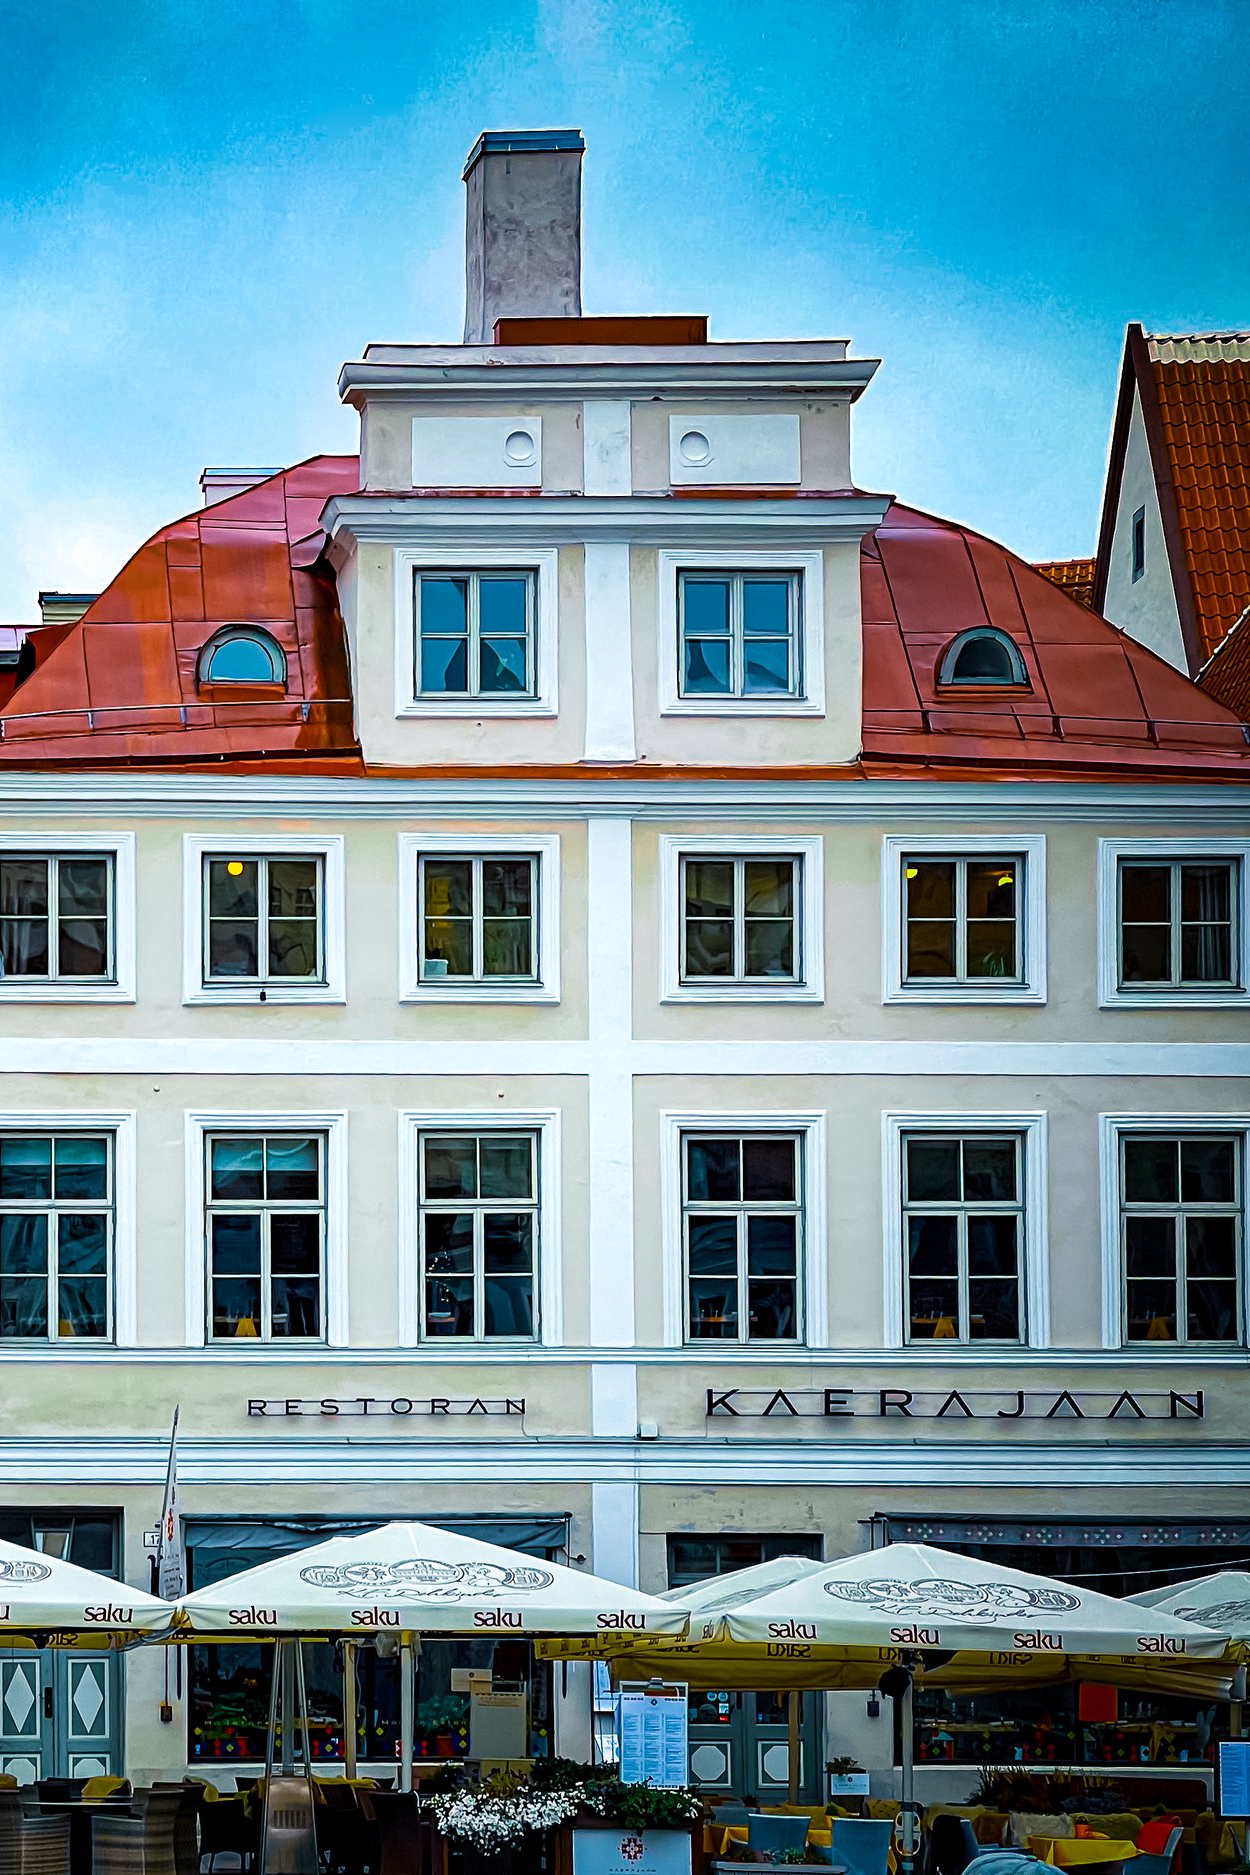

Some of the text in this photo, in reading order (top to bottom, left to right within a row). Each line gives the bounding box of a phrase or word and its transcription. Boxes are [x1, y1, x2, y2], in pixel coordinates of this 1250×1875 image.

[248, 1398, 526, 1416] RESTORAN
[706, 1388, 1204, 1419] KAERAJAAN
[83, 1603, 133, 1623] saku
[228, 1605, 277, 1625] saku
[350, 1606, 400, 1626] saku
[473, 1607, 523, 1627] saku
[597, 1609, 646, 1629] saku
[768, 1619, 817, 1639] saku
[890, 1624, 940, 1644] saku
[1013, 1630, 1063, 1649] saku
[1136, 1634, 1186, 1653] saku
